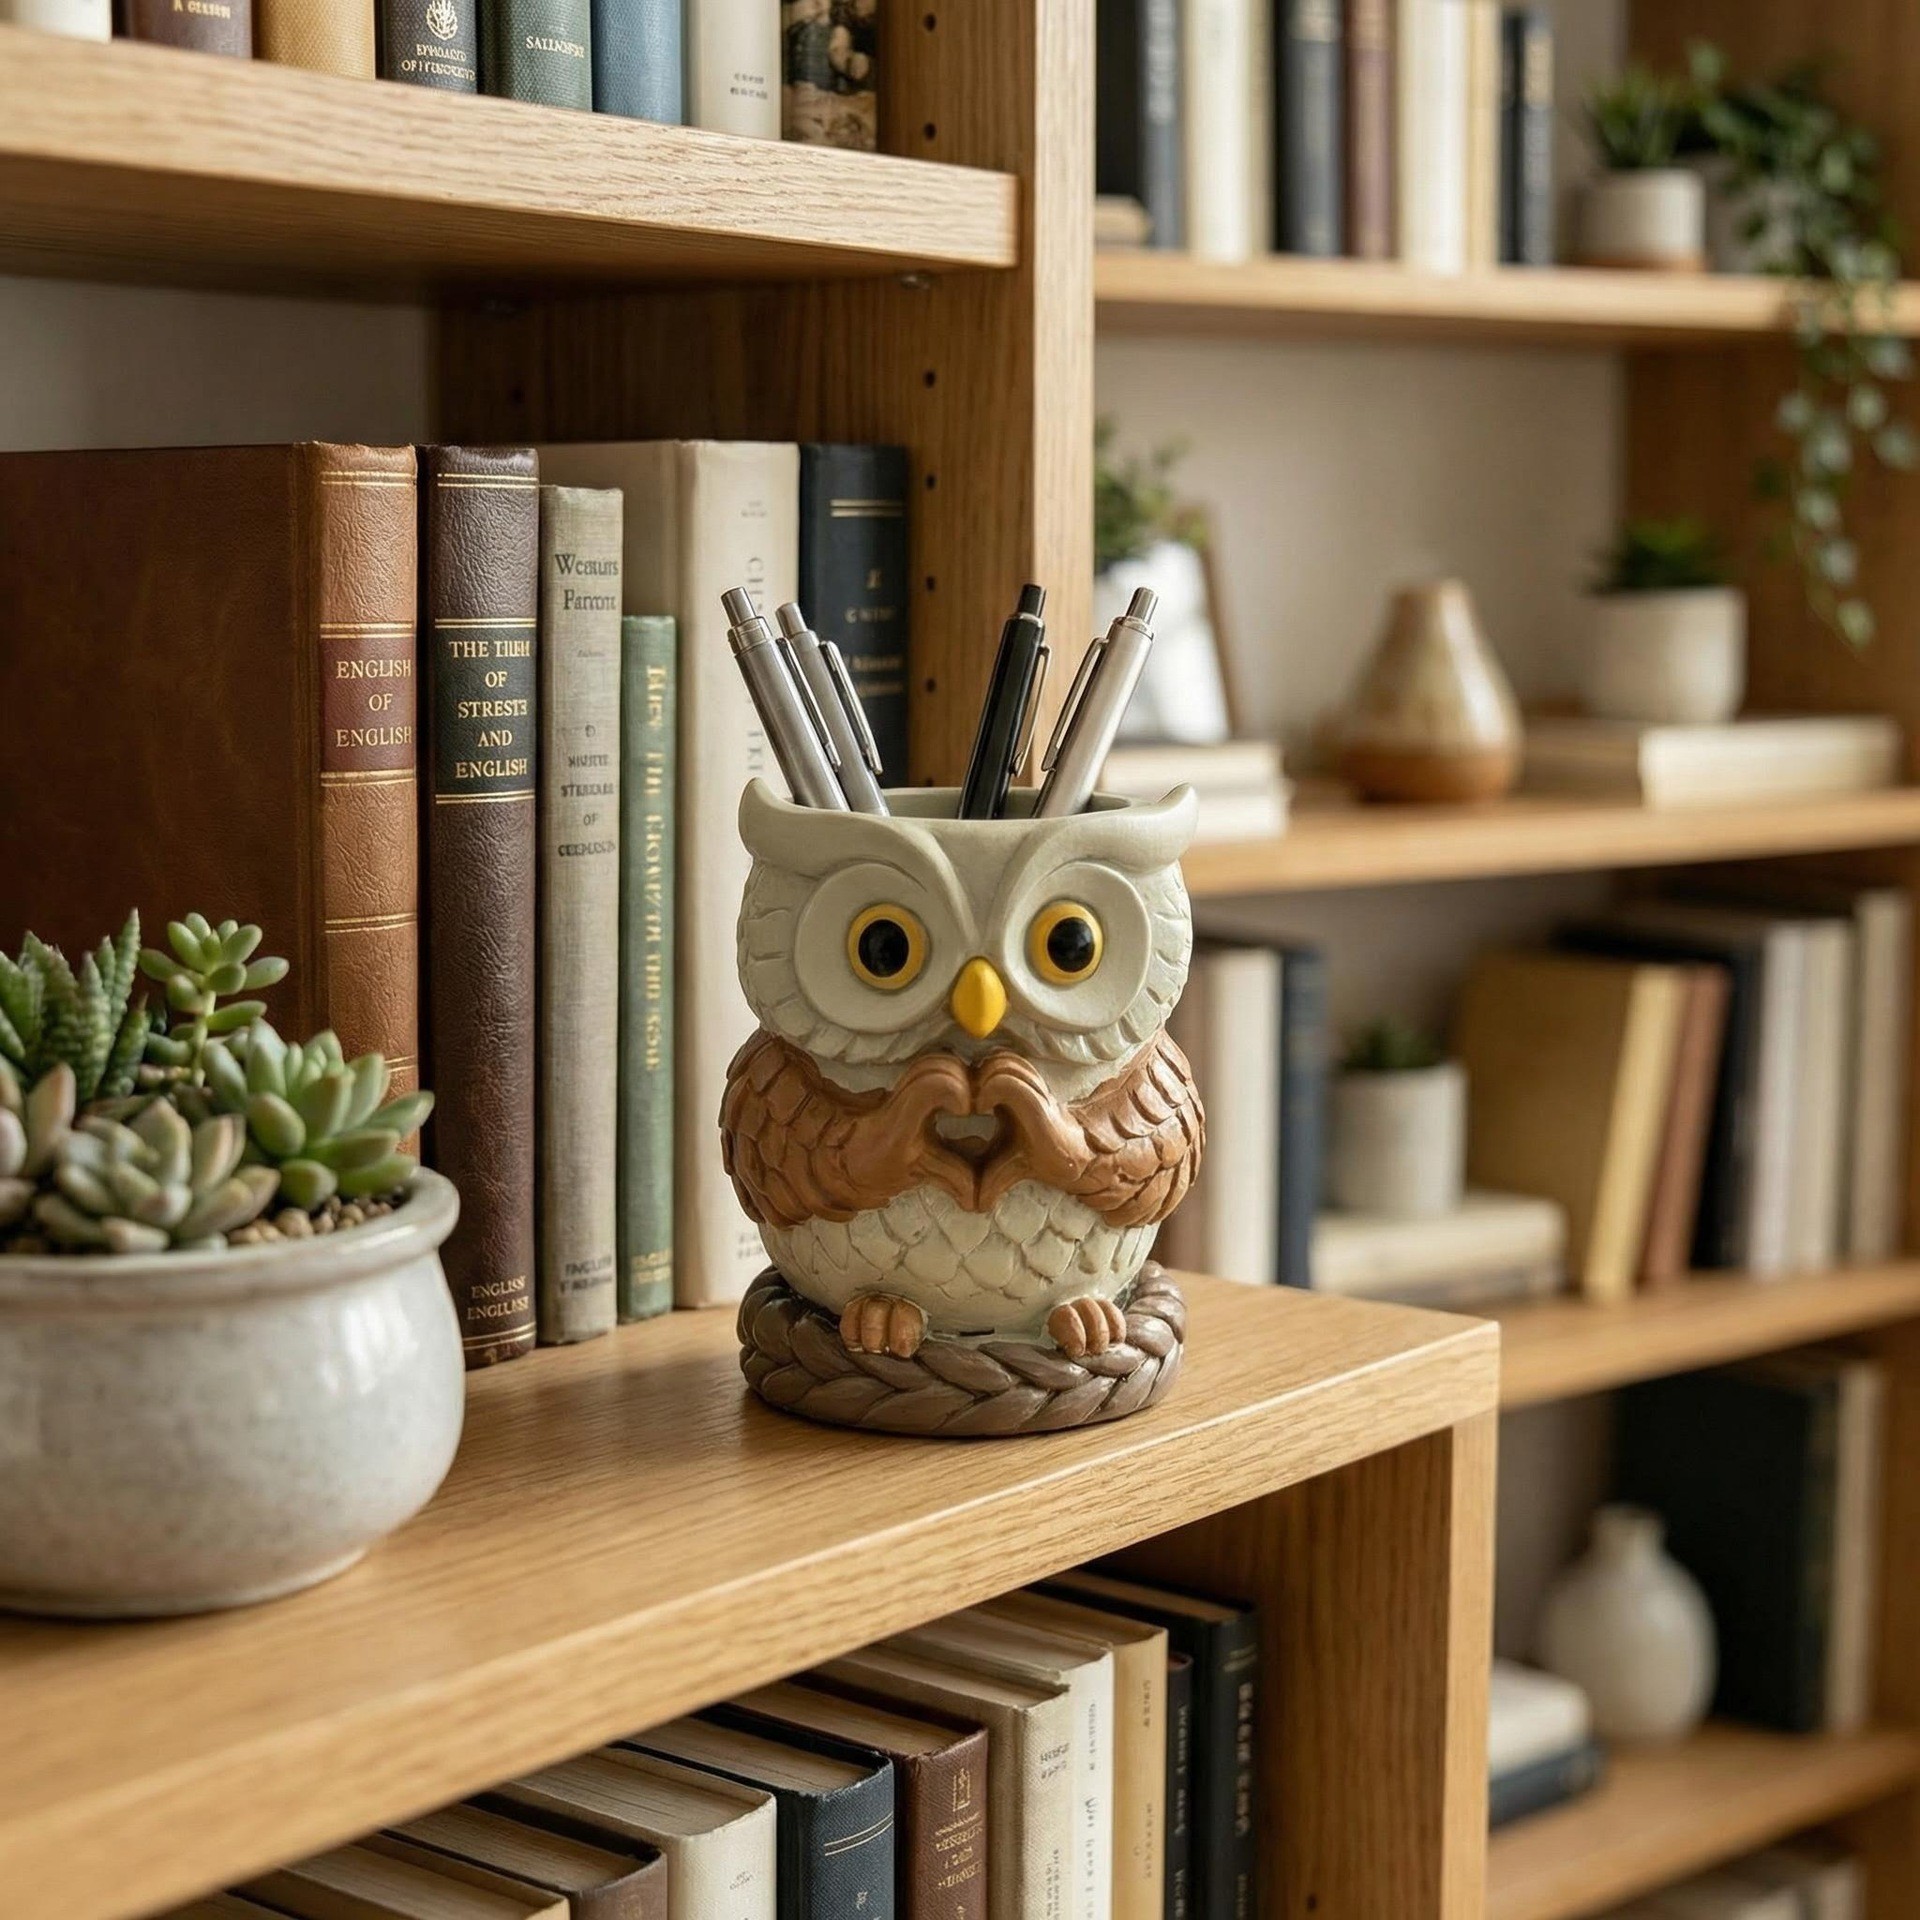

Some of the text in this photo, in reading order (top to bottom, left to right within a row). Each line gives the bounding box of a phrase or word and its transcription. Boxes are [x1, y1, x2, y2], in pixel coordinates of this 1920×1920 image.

[448, 640, 489, 659] THE
[335, 659, 412, 679] ENGLISH
[484, 671, 508, 688] OF
[368, 693, 394, 712] OF
[335, 726, 413, 748] ENGLISH
[477, 730, 513, 748] AND
[455, 758, 528, 779] ENGLISH
